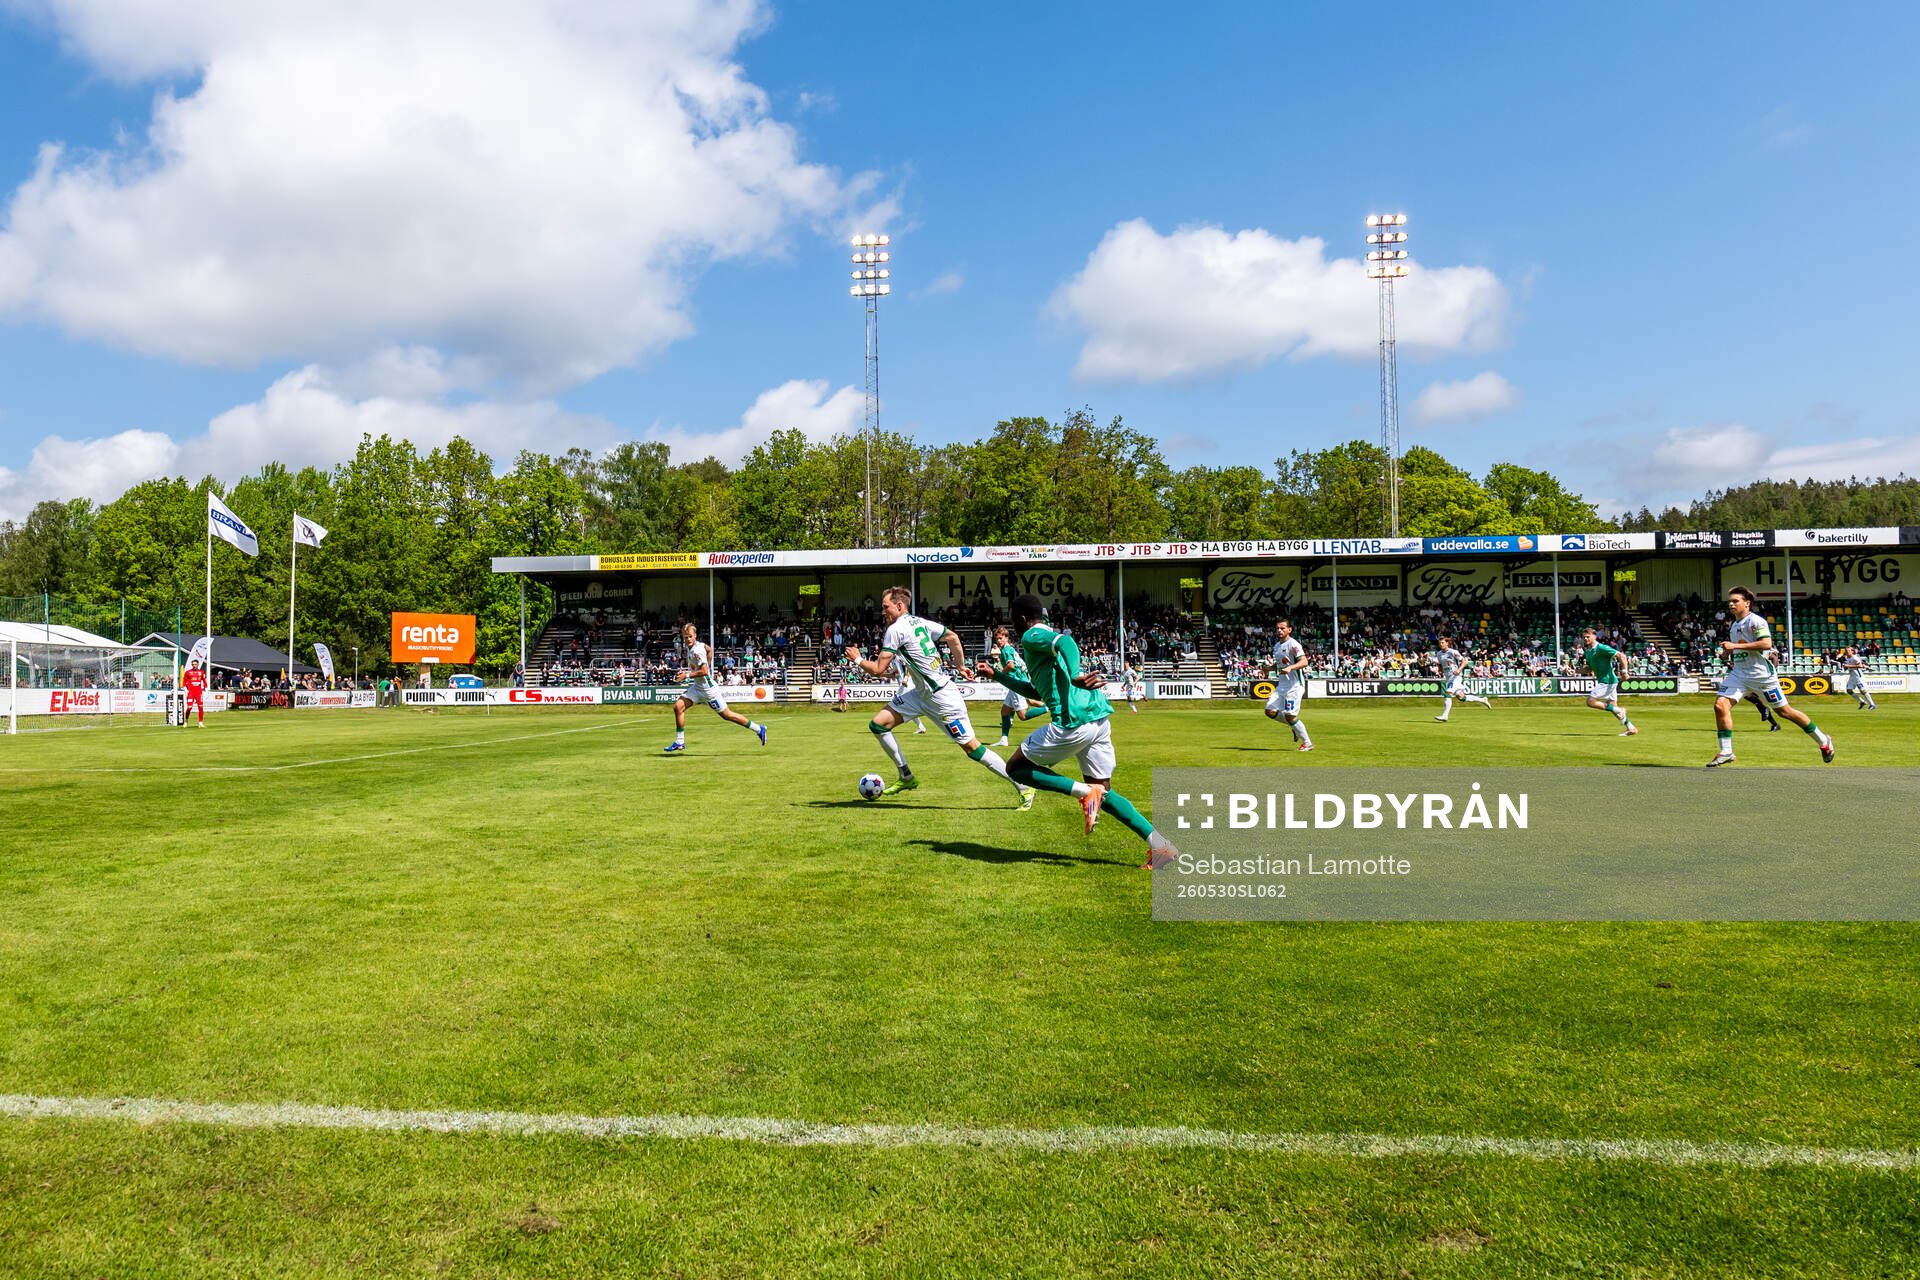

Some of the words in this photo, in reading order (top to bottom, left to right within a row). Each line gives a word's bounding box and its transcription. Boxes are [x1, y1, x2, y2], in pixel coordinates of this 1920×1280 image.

[211, 509, 256, 540] BRAN
[1665, 533, 1697, 545] Bröderna
[1698, 532, 1721, 545] Björks
[1818, 533, 1868, 544] bakertilly
[1131, 545, 1151, 555] JTB
[1167, 544, 1188, 554] JTB
[1202, 543, 1220, 552] H.A
[1223, 542, 1252, 552] BYGG
[1257, 542, 1276, 551] H.A
[1279, 541, 1308, 551] BYGG
[1313, 540, 1381, 554] LLENTAB
[1431, 540, 1509, 551] uddevalla.se
[1589, 540, 1631, 549] BioTech
[1095, 546, 1115, 556] JTB
[636, 555, 687, 563] INDUSTRISERVICE
[708, 553, 774, 566] Autoexperten
[907, 552, 959, 562] Nordea
[1756, 560, 1806, 584] H.A
[1815, 558, 1900, 584] BYGG
[949, 574, 992, 597] H.A
[1001, 573, 1074, 597] BYGG
[1317, 578, 1392, 588] BRANDT
[1413, 568, 1497, 601] Ford
[1518, 575, 1597, 585] BRANDT
[1213, 571, 1295, 603] Ford
[402, 624, 459, 643] renta
[1159, 685, 1192, 695] PUMA
[1329, 682, 1380, 693] UNIBET
[1464, 680, 1536, 694] SUPERETTAN
[1560, 680, 1597, 692] UNIB
[406, 692, 435, 702] PUMA
[455, 692, 484, 702] PUMA
[509, 690, 542, 702] CS
[604, 690, 651, 700] BVAB.NU
[50, 690, 100, 712] El-Väst
